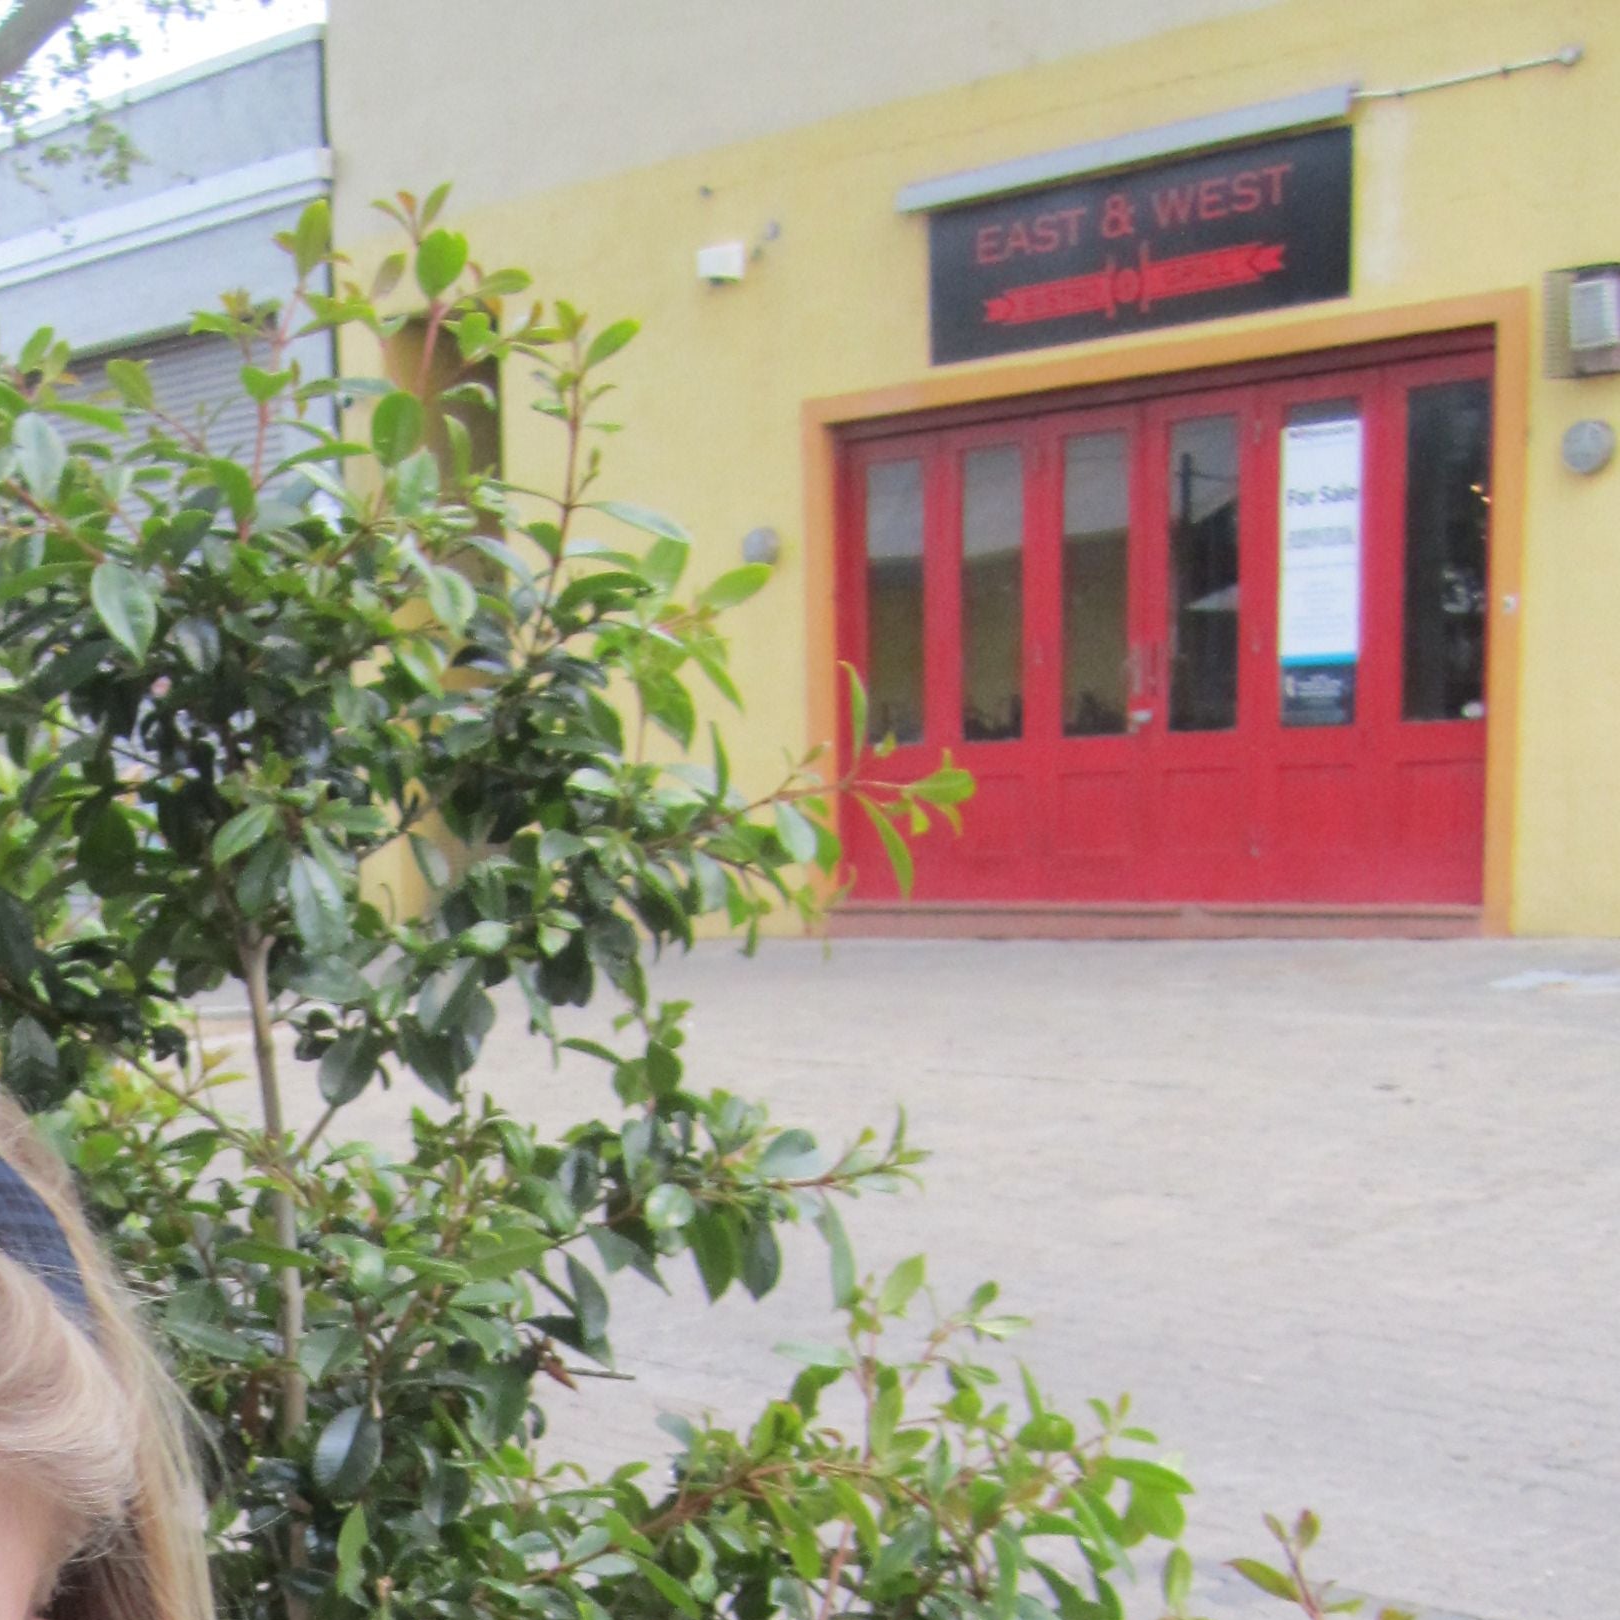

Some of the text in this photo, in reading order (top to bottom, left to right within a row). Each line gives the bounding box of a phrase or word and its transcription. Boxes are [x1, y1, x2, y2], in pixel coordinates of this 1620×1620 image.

[977, 163, 1292, 265] EAST & WEST
[1287, 484, 1359, 506] For Sale
